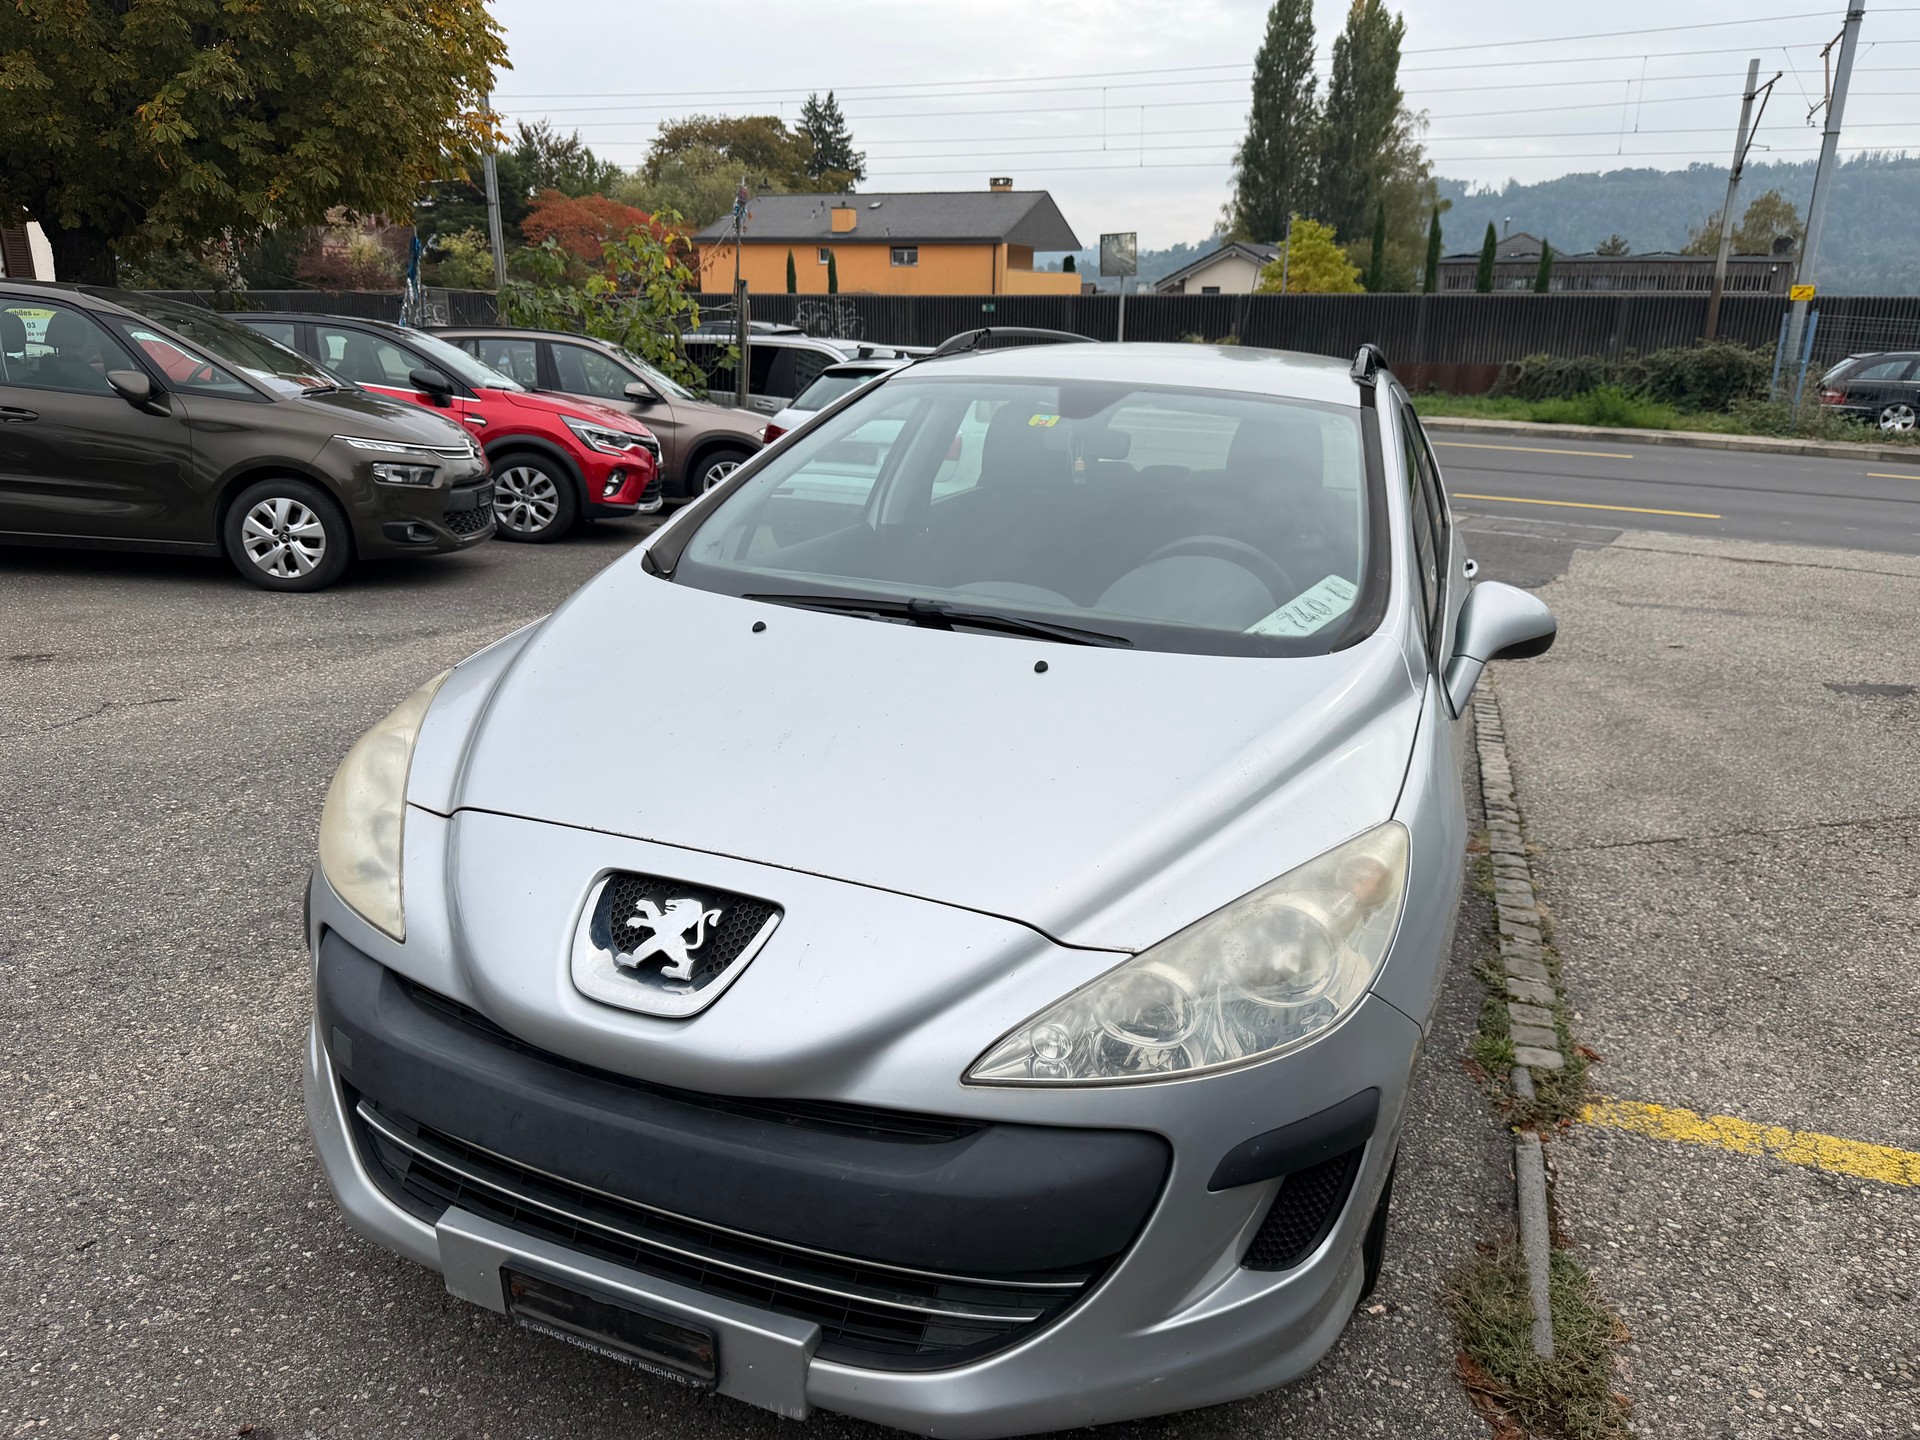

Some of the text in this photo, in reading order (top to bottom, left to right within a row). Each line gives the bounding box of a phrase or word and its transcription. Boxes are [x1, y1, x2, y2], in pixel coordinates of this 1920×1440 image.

[531, 1324, 688, 1384] GARAGE CLAUDE MOSSET NEUCHATEL
